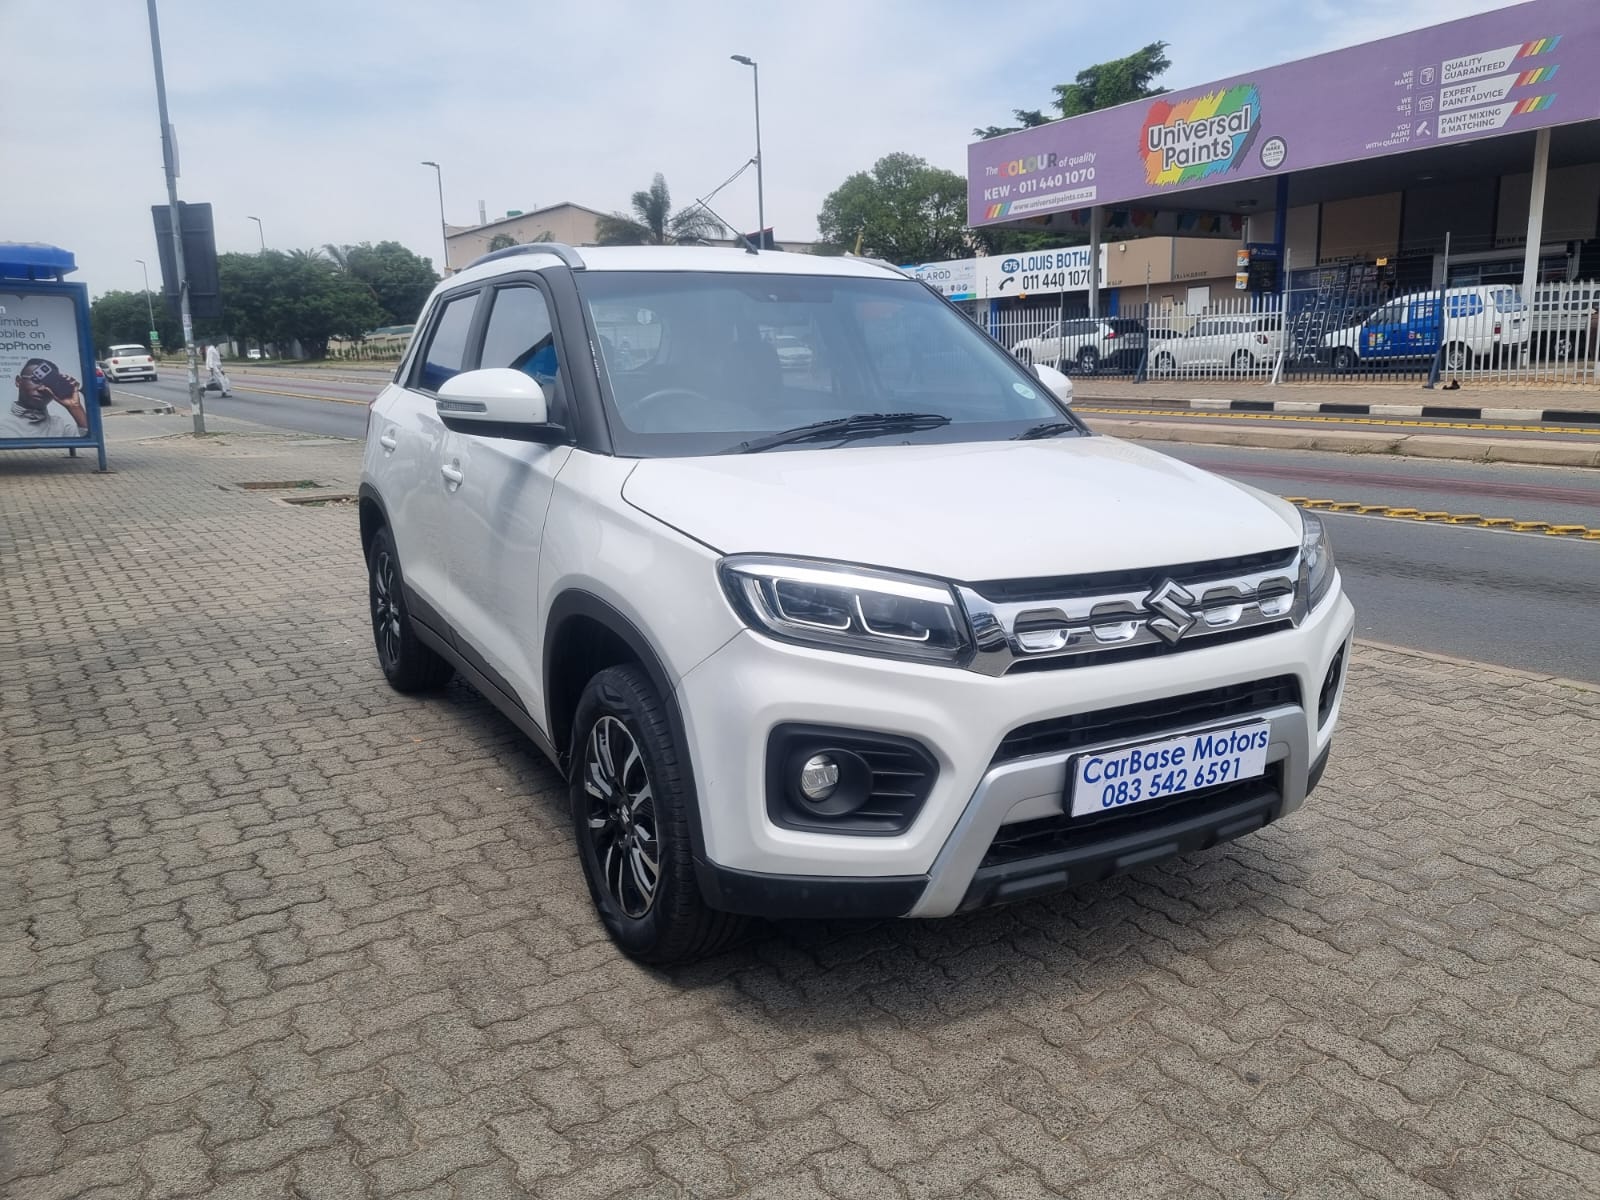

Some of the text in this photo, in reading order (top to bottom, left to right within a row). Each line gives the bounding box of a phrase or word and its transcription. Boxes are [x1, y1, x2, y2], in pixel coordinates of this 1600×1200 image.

[1444, 61, 1506, 80] GUARANTEED
[1445, 57, 1483, 72] QUALITY
[1394, 77, 1413, 86] MAKE
[1402, 70, 1414, 78] WE
[1442, 89, 1504, 107] PAINT ADVICE
[1443, 85, 1477, 99] EXPERT
[1397, 104, 1411, 112] SELL
[1441, 108, 1502, 125] PAINT MIXING
[1149, 107, 1249, 149] Universal
[1391, 129, 1410, 138] PAINT
[1397, 122, 1411, 131] YOU
[1448, 118, 1495, 133] MATCHING
[1365, 137, 1409, 150] WITH QUALITY
[1164, 138, 1231, 168] Paints
[985, 151, 1097, 178] The COLOUR of quality
[984, 184, 1011, 201] KEW
[1019, 179, 1037, 194] 011
[1039, 174, 1063, 190] 440
[1064, 167, 1096, 185] 1070
[1013, 191, 1093, 210] www.universalpaints.co.za
[1004, 261, 1018, 270] 575
[1021, 254, 1053, 273] LOUIS
[1022, 273, 1039, 290] 011
[1042, 271, 1065, 287] 440
[29, 331, 46, 339] on
[1083, 729, 1268, 784] CarBase Motors
[1101, 757, 1242, 808] 083 542 6591
